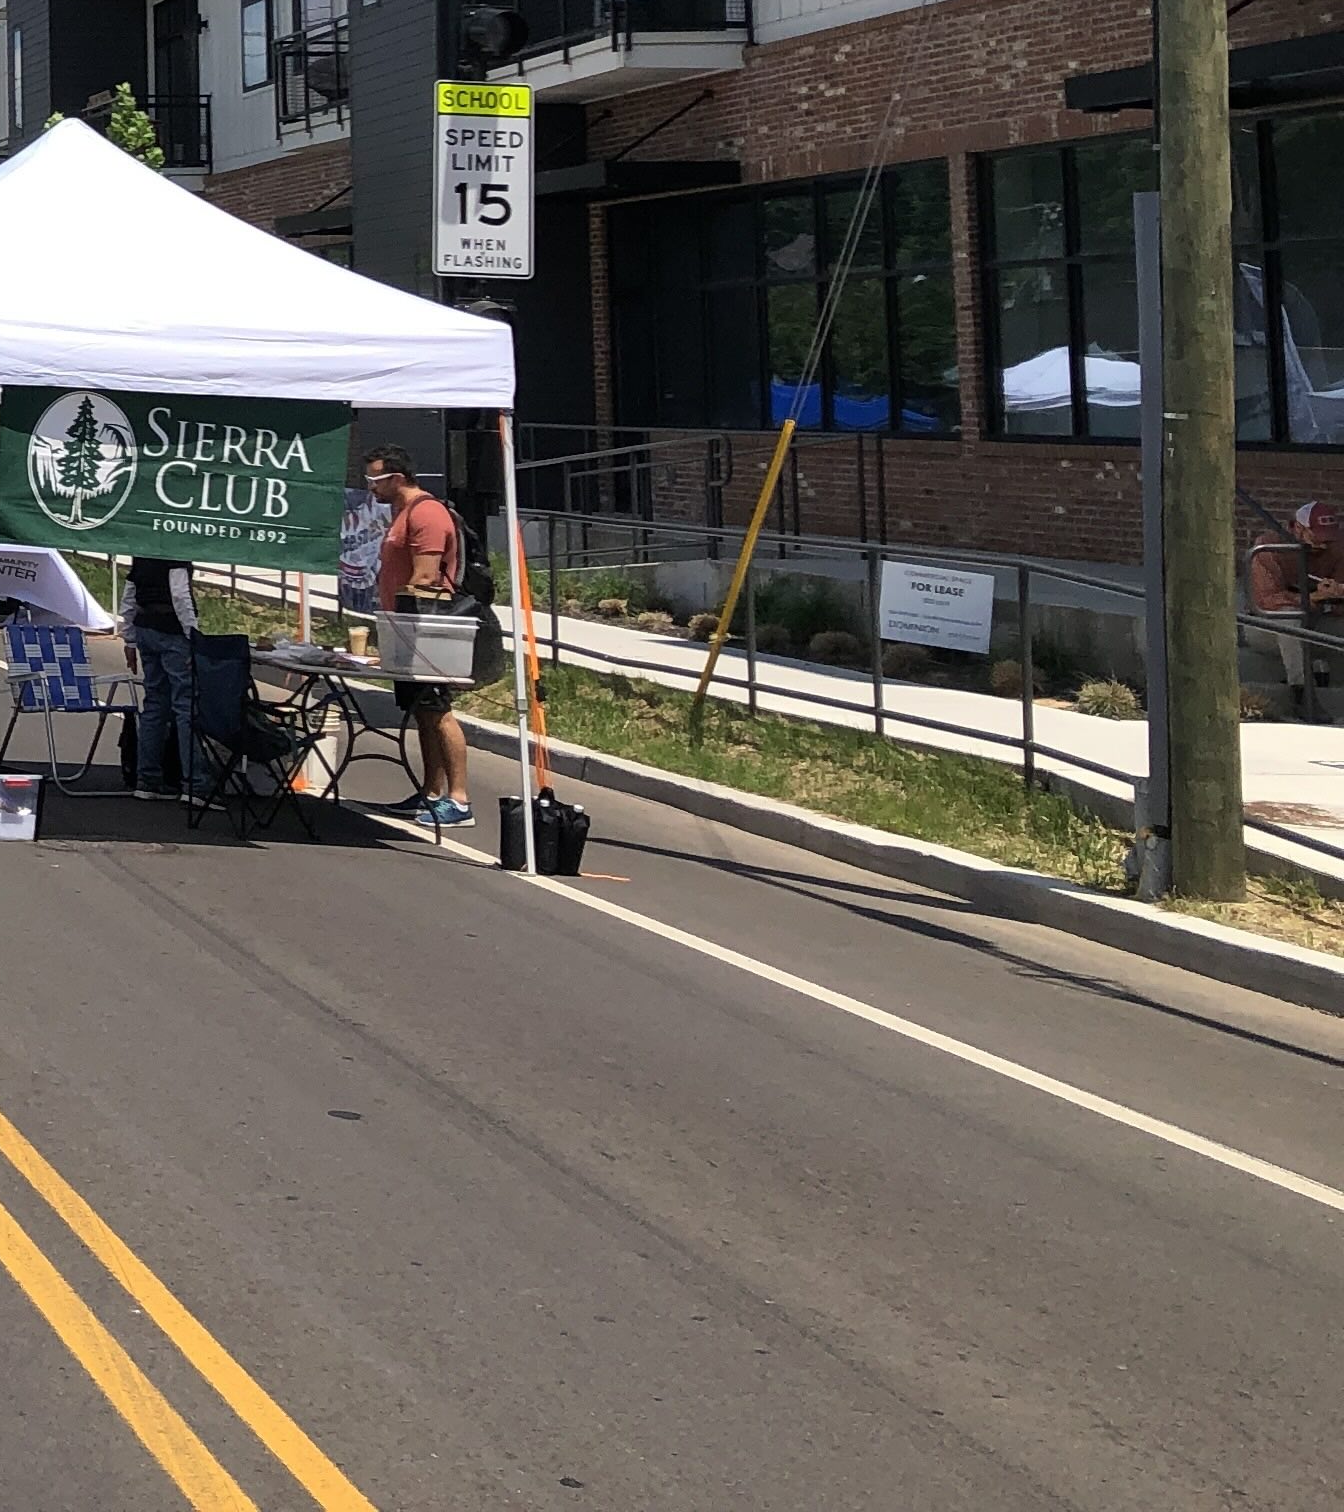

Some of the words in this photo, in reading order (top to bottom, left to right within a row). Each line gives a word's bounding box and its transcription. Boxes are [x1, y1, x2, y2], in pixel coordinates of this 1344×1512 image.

[442, 89, 526, 110] SCHOOL
[444, 129, 524, 148] SPEED
[452, 153, 515, 172] LIMIT
[454, 182, 511, 226] 15
[461, 238, 506, 251] WHEN
[443, 254, 522, 269] FLASHING
[143, 407, 313, 472] SIERRA
[155, 461, 289, 518] CLUB
[153, 518, 241, 539] FOUNDED
[249, 529, 287, 544] 1892
[911, 582, 933, 593] FOR
[934, 585, 965, 597] LEASE
[888, 619, 940, 634] DOMINION
